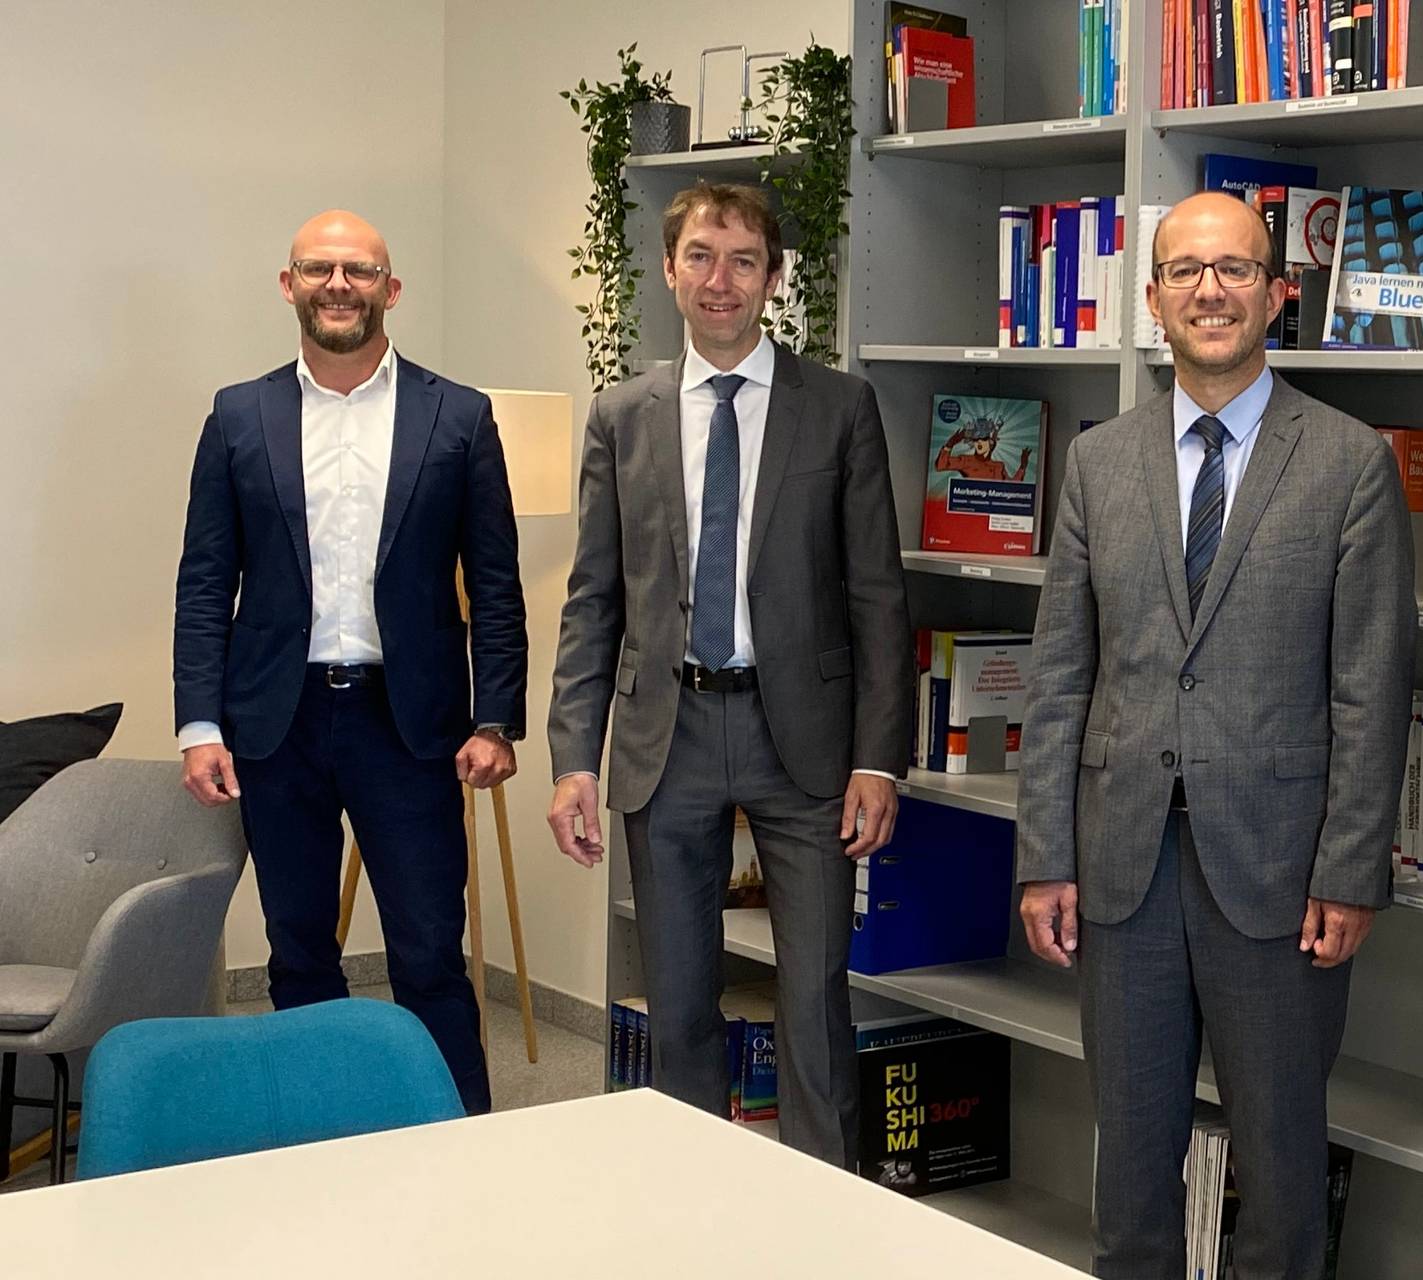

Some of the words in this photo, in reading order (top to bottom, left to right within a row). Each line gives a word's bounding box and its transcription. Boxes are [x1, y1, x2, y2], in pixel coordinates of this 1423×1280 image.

[1222, 178, 1261, 191] AutoCAD
[1353, 273, 1376, 286] Java
[1378, 275, 1413, 287] lernen
[953, 487, 1032, 499] Marketing-Management
[1407, 782, 1416, 830] HANDBUCH
[886, 1063, 917, 1086] FU
[886, 1088, 917, 1108] KU
[886, 1105, 925, 1131] SHI
[929, 1096, 979, 1123] 360°
[887, 1129, 919, 1153] MA
